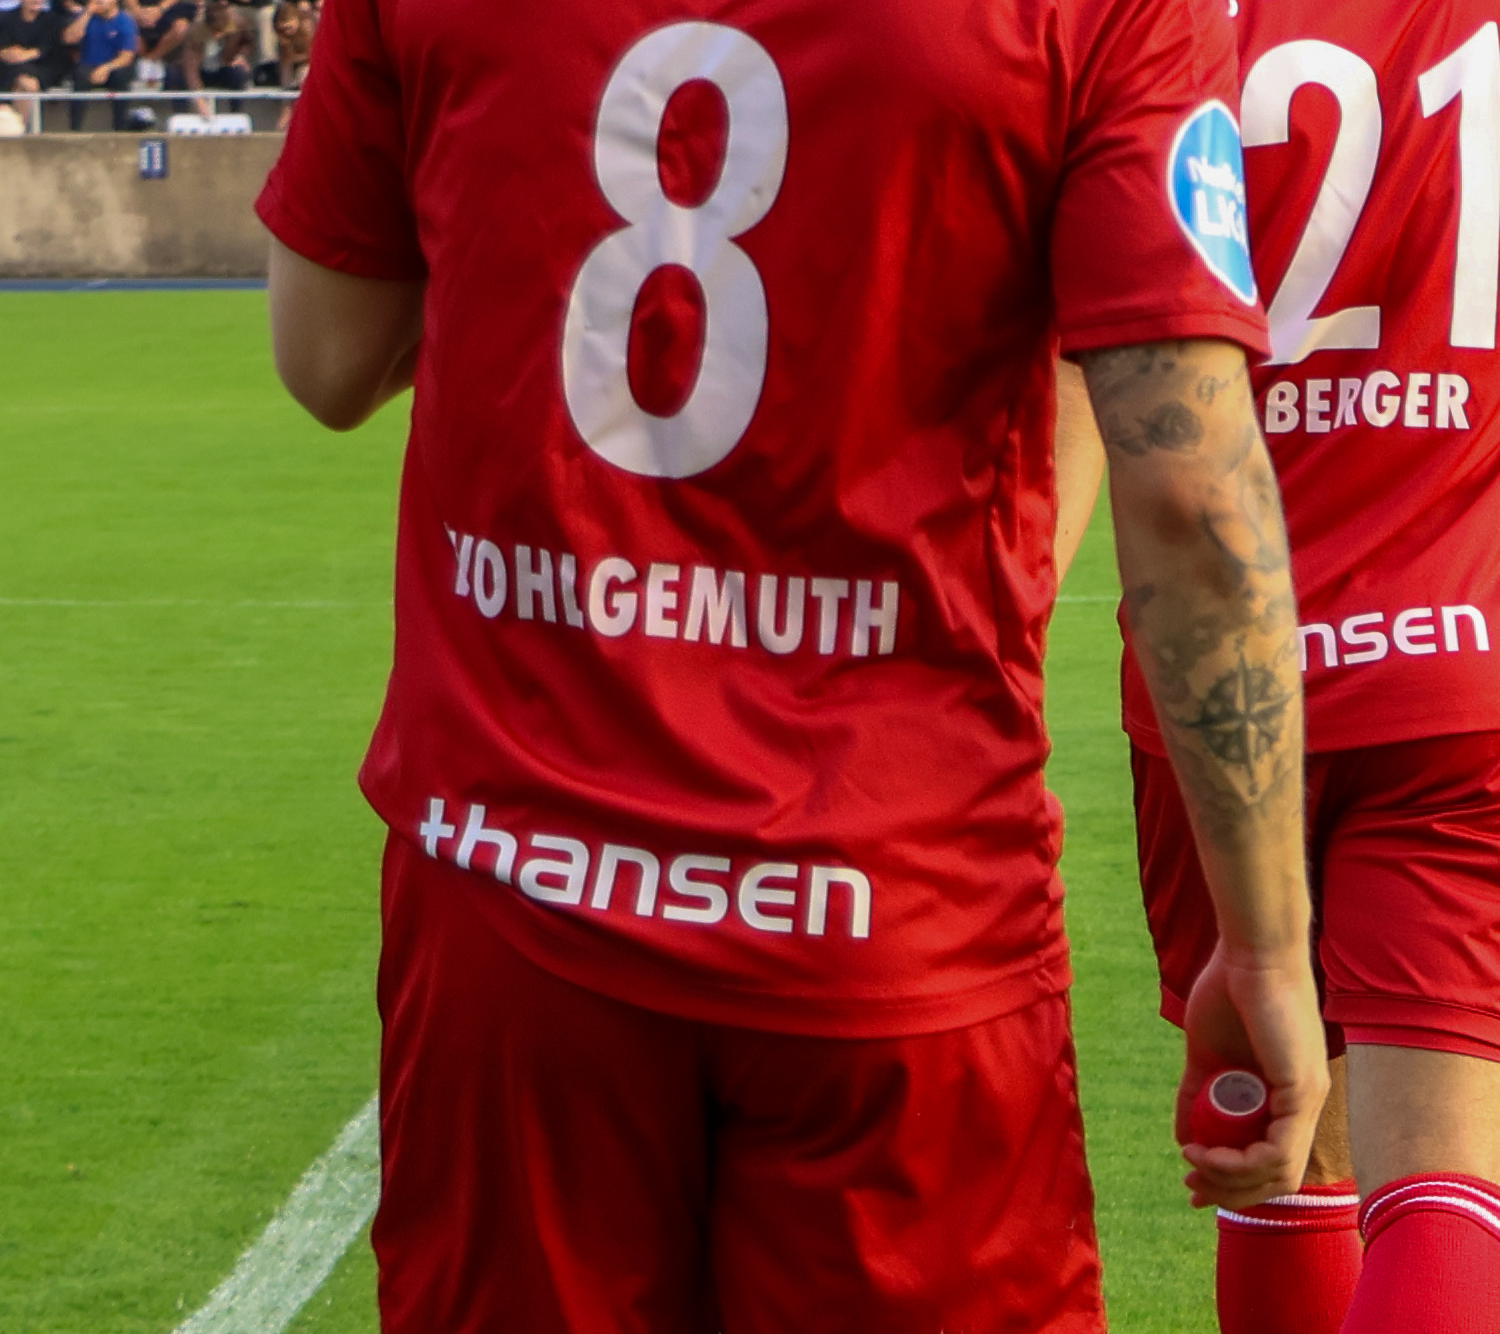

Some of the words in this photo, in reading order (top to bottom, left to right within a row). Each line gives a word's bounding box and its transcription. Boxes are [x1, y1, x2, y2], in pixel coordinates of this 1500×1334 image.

[562, 19, 790, 480] 8
[1265, 370, 1471, 434] BERGER
[1296, 604, 1491, 672] nsen
[419, 797, 873, 940] thansen
